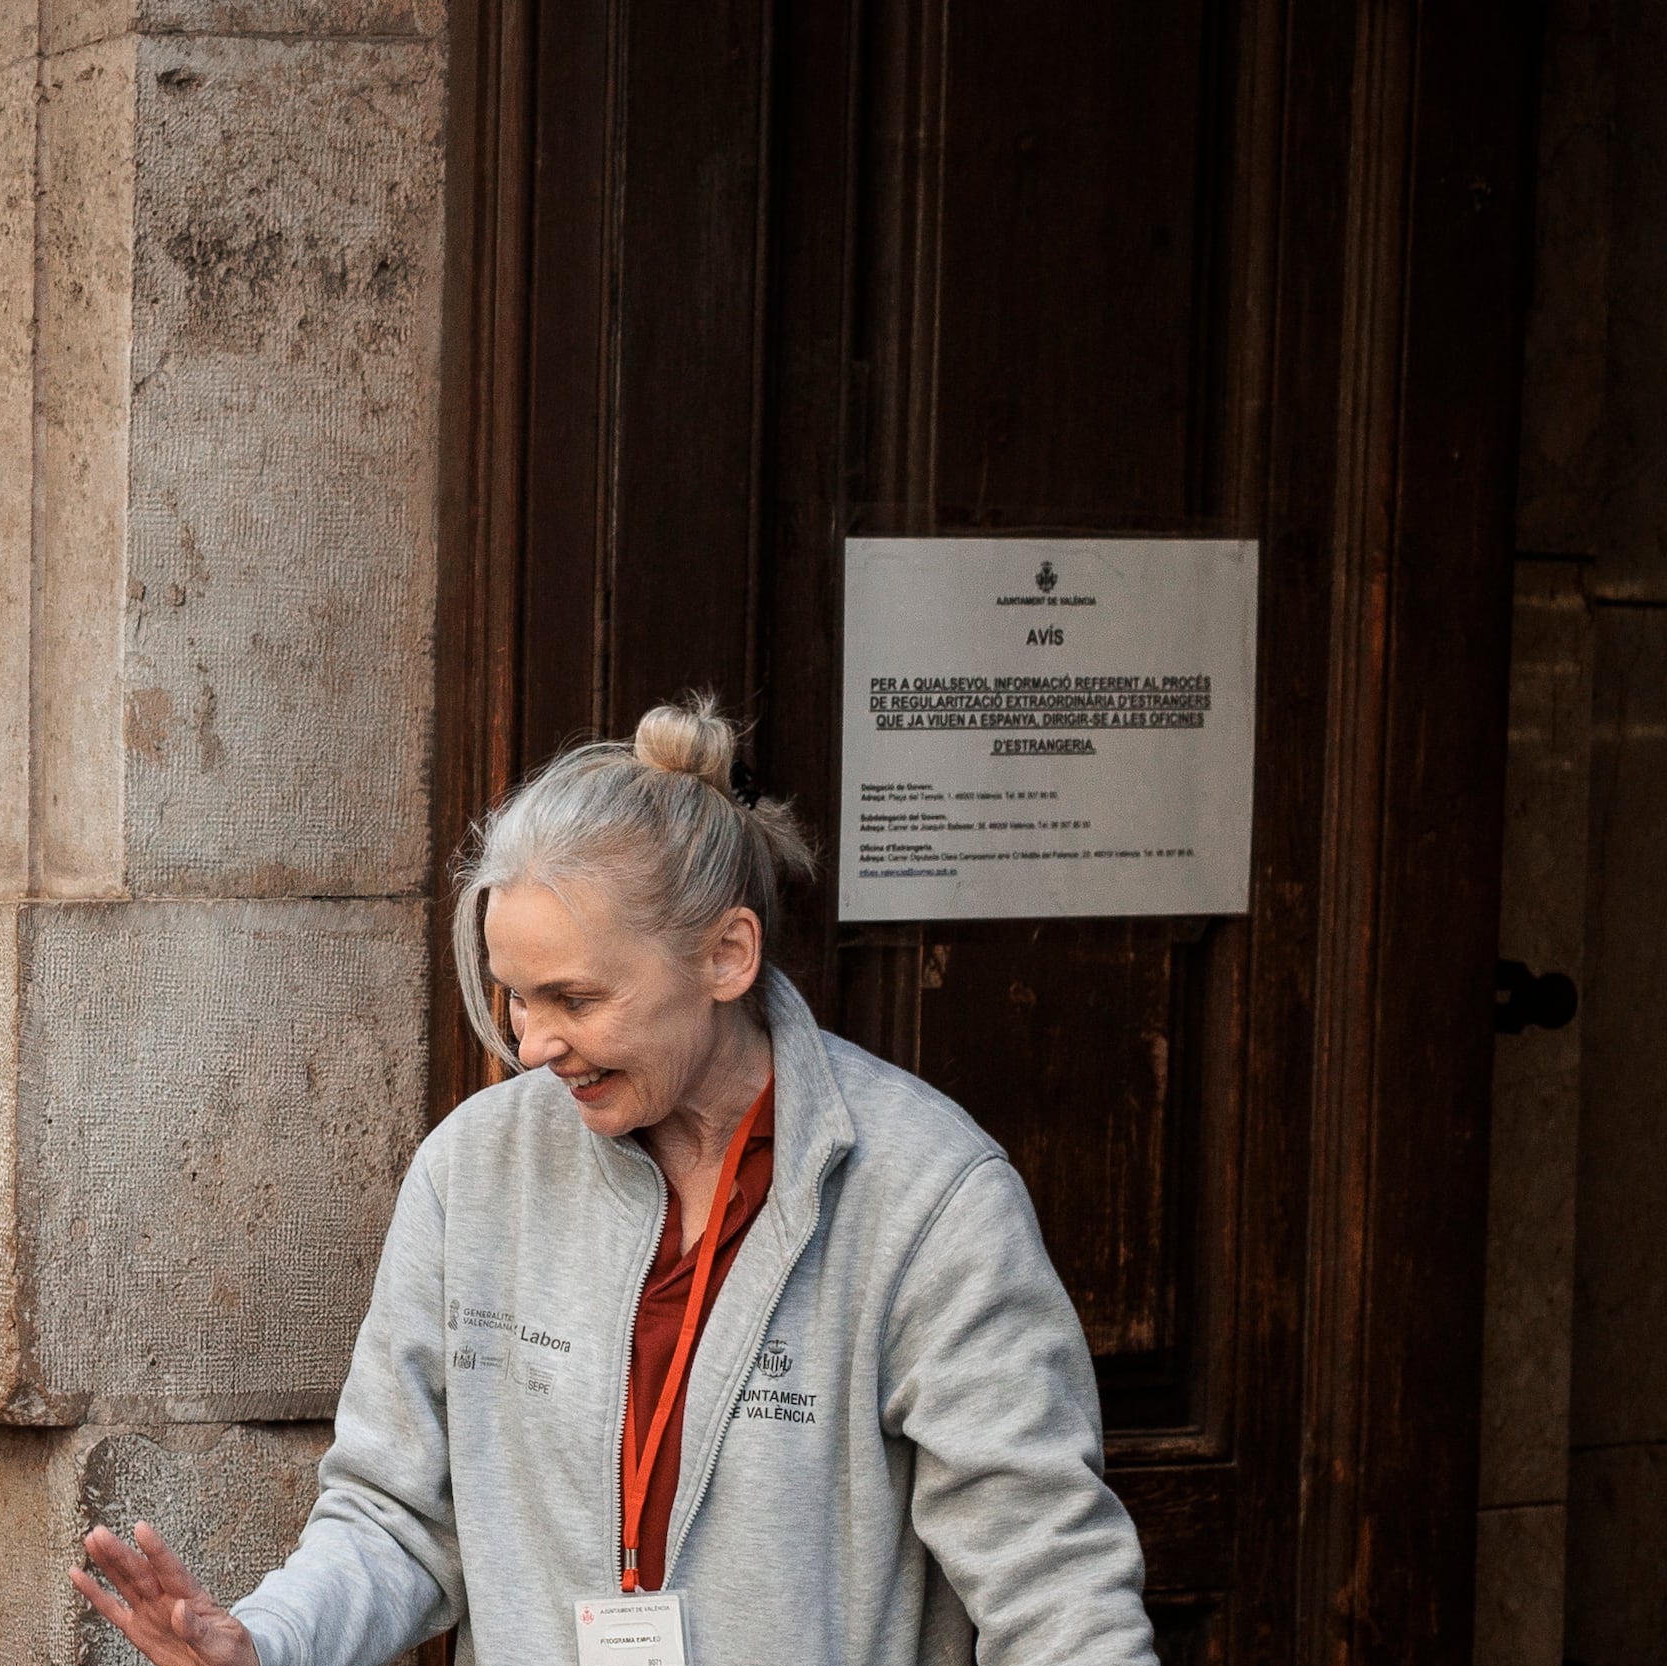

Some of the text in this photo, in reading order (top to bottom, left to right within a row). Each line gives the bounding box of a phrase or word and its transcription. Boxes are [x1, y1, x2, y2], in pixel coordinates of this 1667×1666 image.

[871, 677, 897, 690] PER
[900, 678, 910, 690] A
[913, 677, 991, 690] QUALSEVOL
[994, 673, 1072, 690] INFORMACIÓ
[1075, 676, 1140, 690] REFERENT
[1143, 676, 1159, 690] AL
[870, 696, 888, 709] DE
[891, 692, 1003, 709] REGULARITZACIÓ
[876, 714, 904, 728] QUE
[907, 714, 924, 727] JA
[927, 714, 966, 727] VIUEN
[968, 714, 977, 727] A
[1111, 712, 1120, 726] A
[1122, 712, 1147, 726] LES
[1149, 712, 1204, 727] OFICINES
[520, 1325, 571, 1353] Labora
[528, 1379, 551, 1395] SEPE
[738, 1389, 817, 1407] JUNTAMENT
[731, 1404, 816, 1424] E VALÈNCIA
